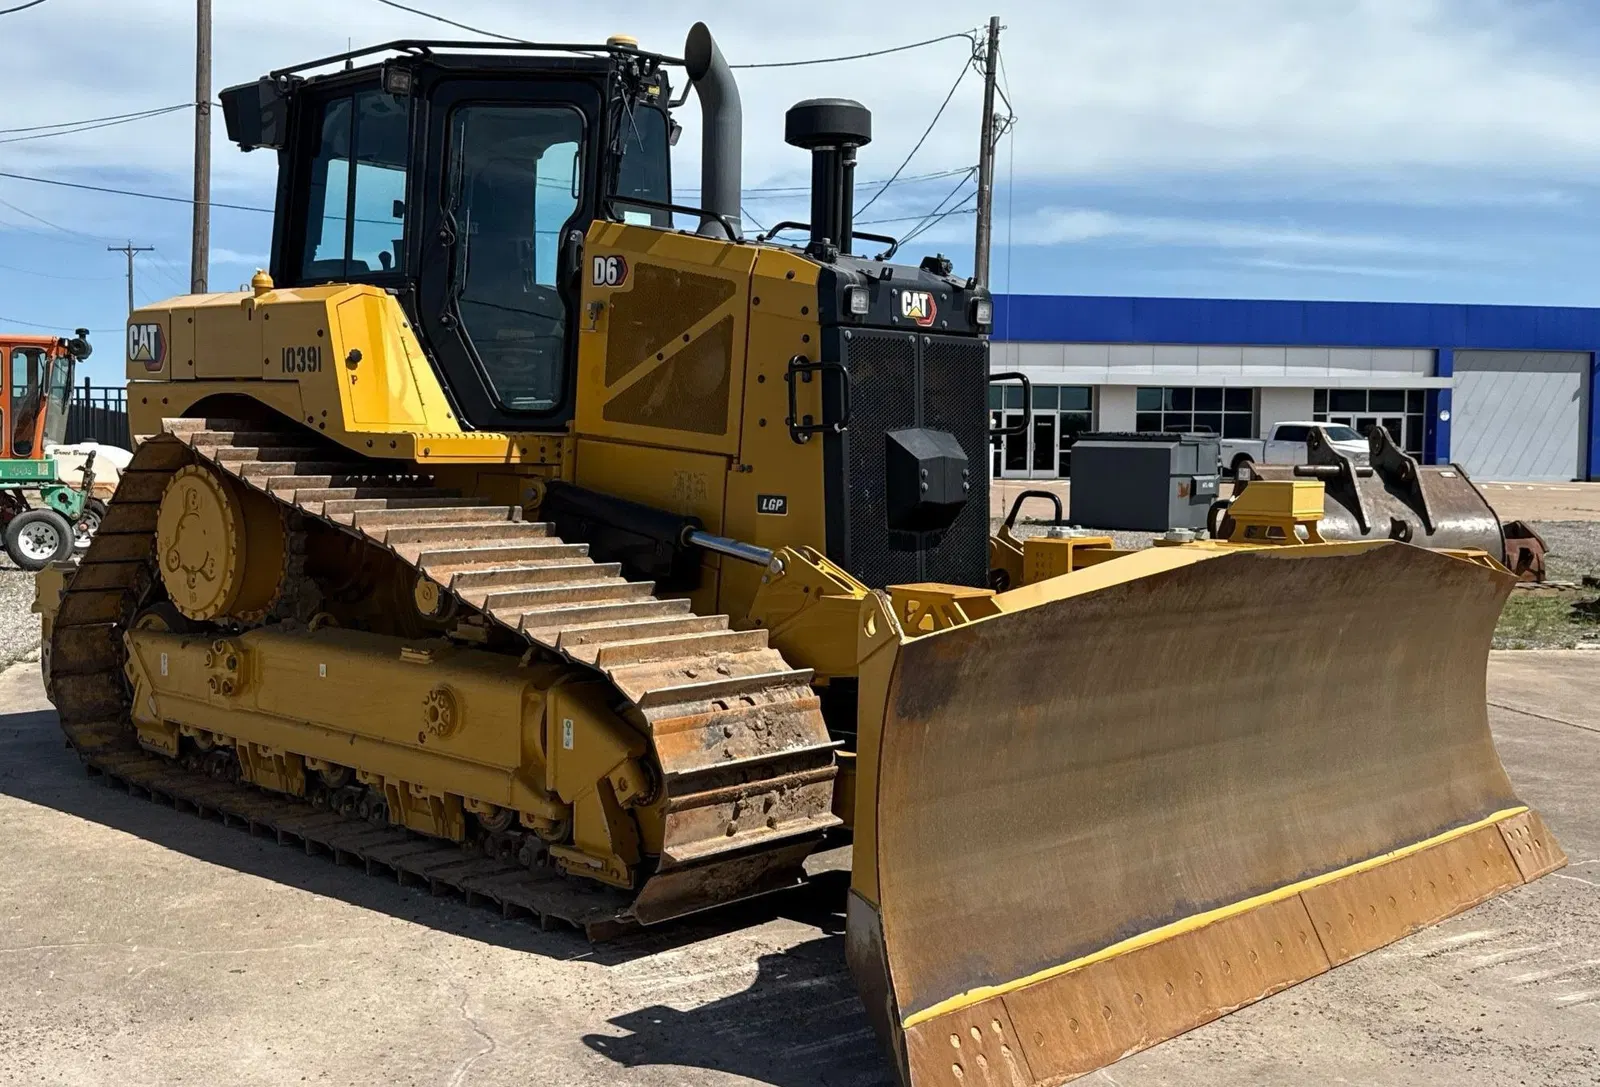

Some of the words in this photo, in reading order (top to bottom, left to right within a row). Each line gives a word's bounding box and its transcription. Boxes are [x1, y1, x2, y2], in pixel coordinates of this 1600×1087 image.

[593, 256, 618, 285] D6
[901, 290, 929, 318] CAT
[128, 324, 158, 361] CAT
[281, 345, 323, 374] 10391
[761, 498, 784, 511] LGP
